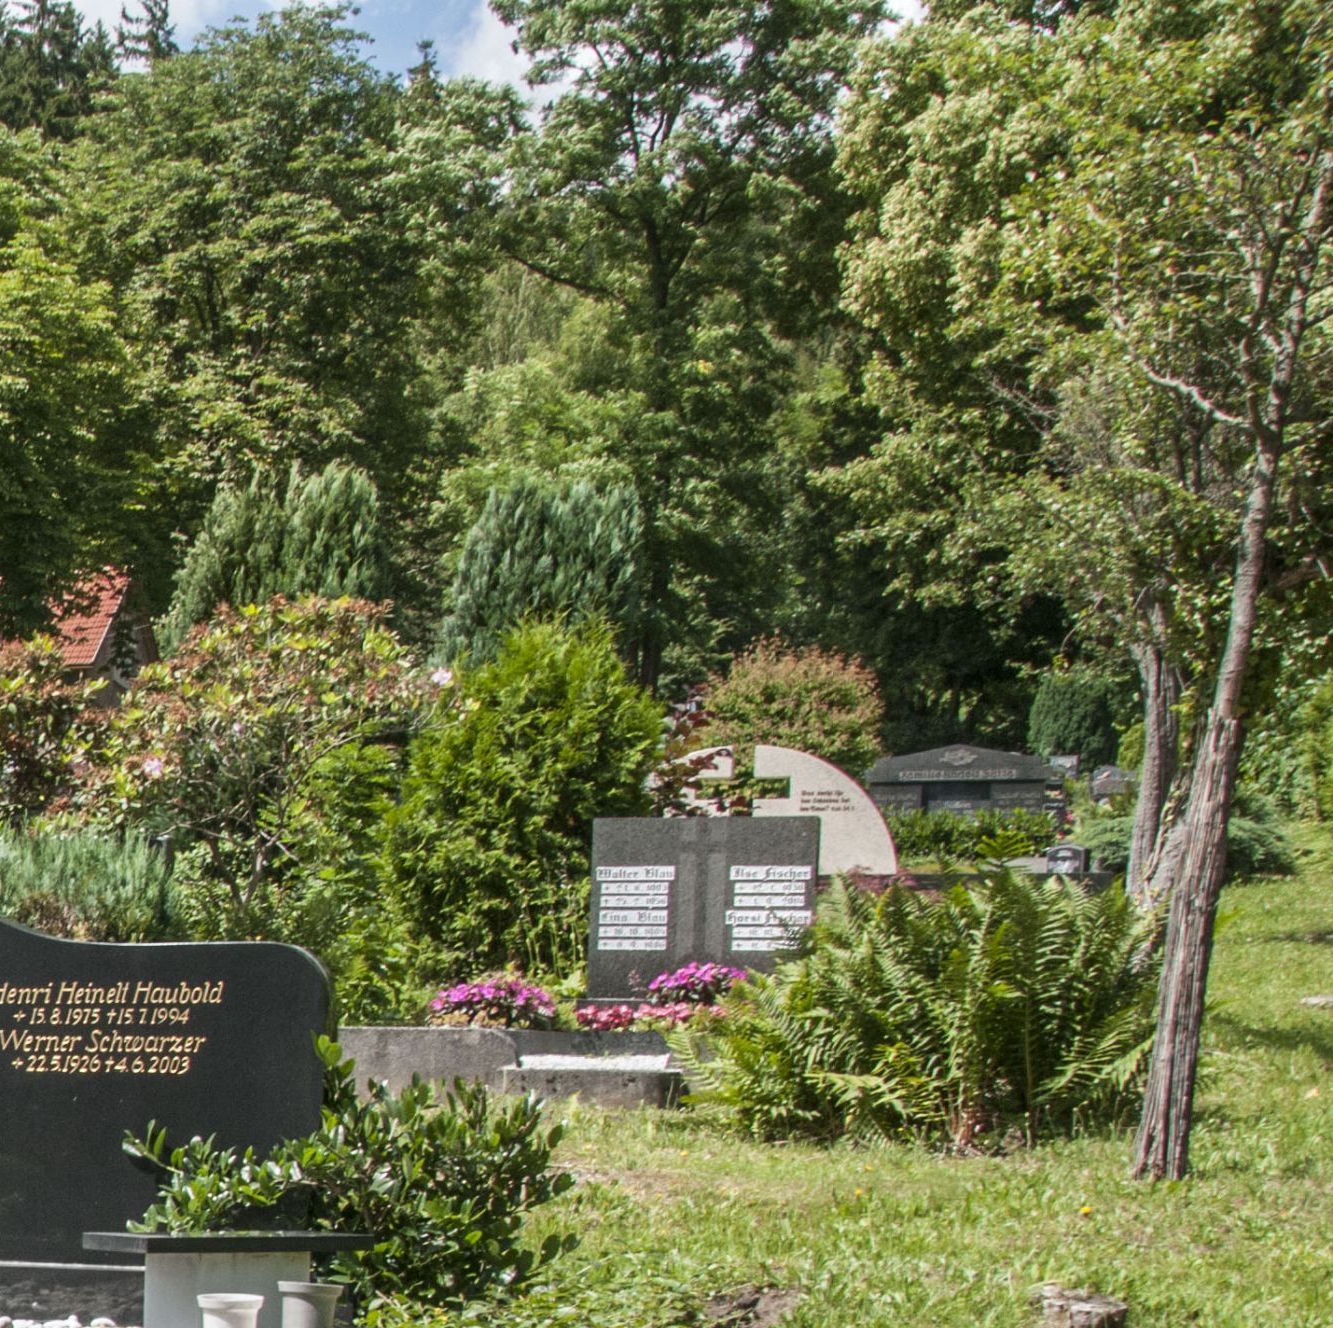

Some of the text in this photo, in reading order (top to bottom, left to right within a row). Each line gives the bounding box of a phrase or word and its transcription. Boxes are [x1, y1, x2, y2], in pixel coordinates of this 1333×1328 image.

[597, 867, 674, 879] Walter Blau
[763, 866, 809, 880] Fischer
[637, 911, 666, 923] Blau
[55, 981, 130, 1005] Heinelt
[131, 981, 225, 1005] Haubold
[84, 1029, 207, 1053] Schwarzer
